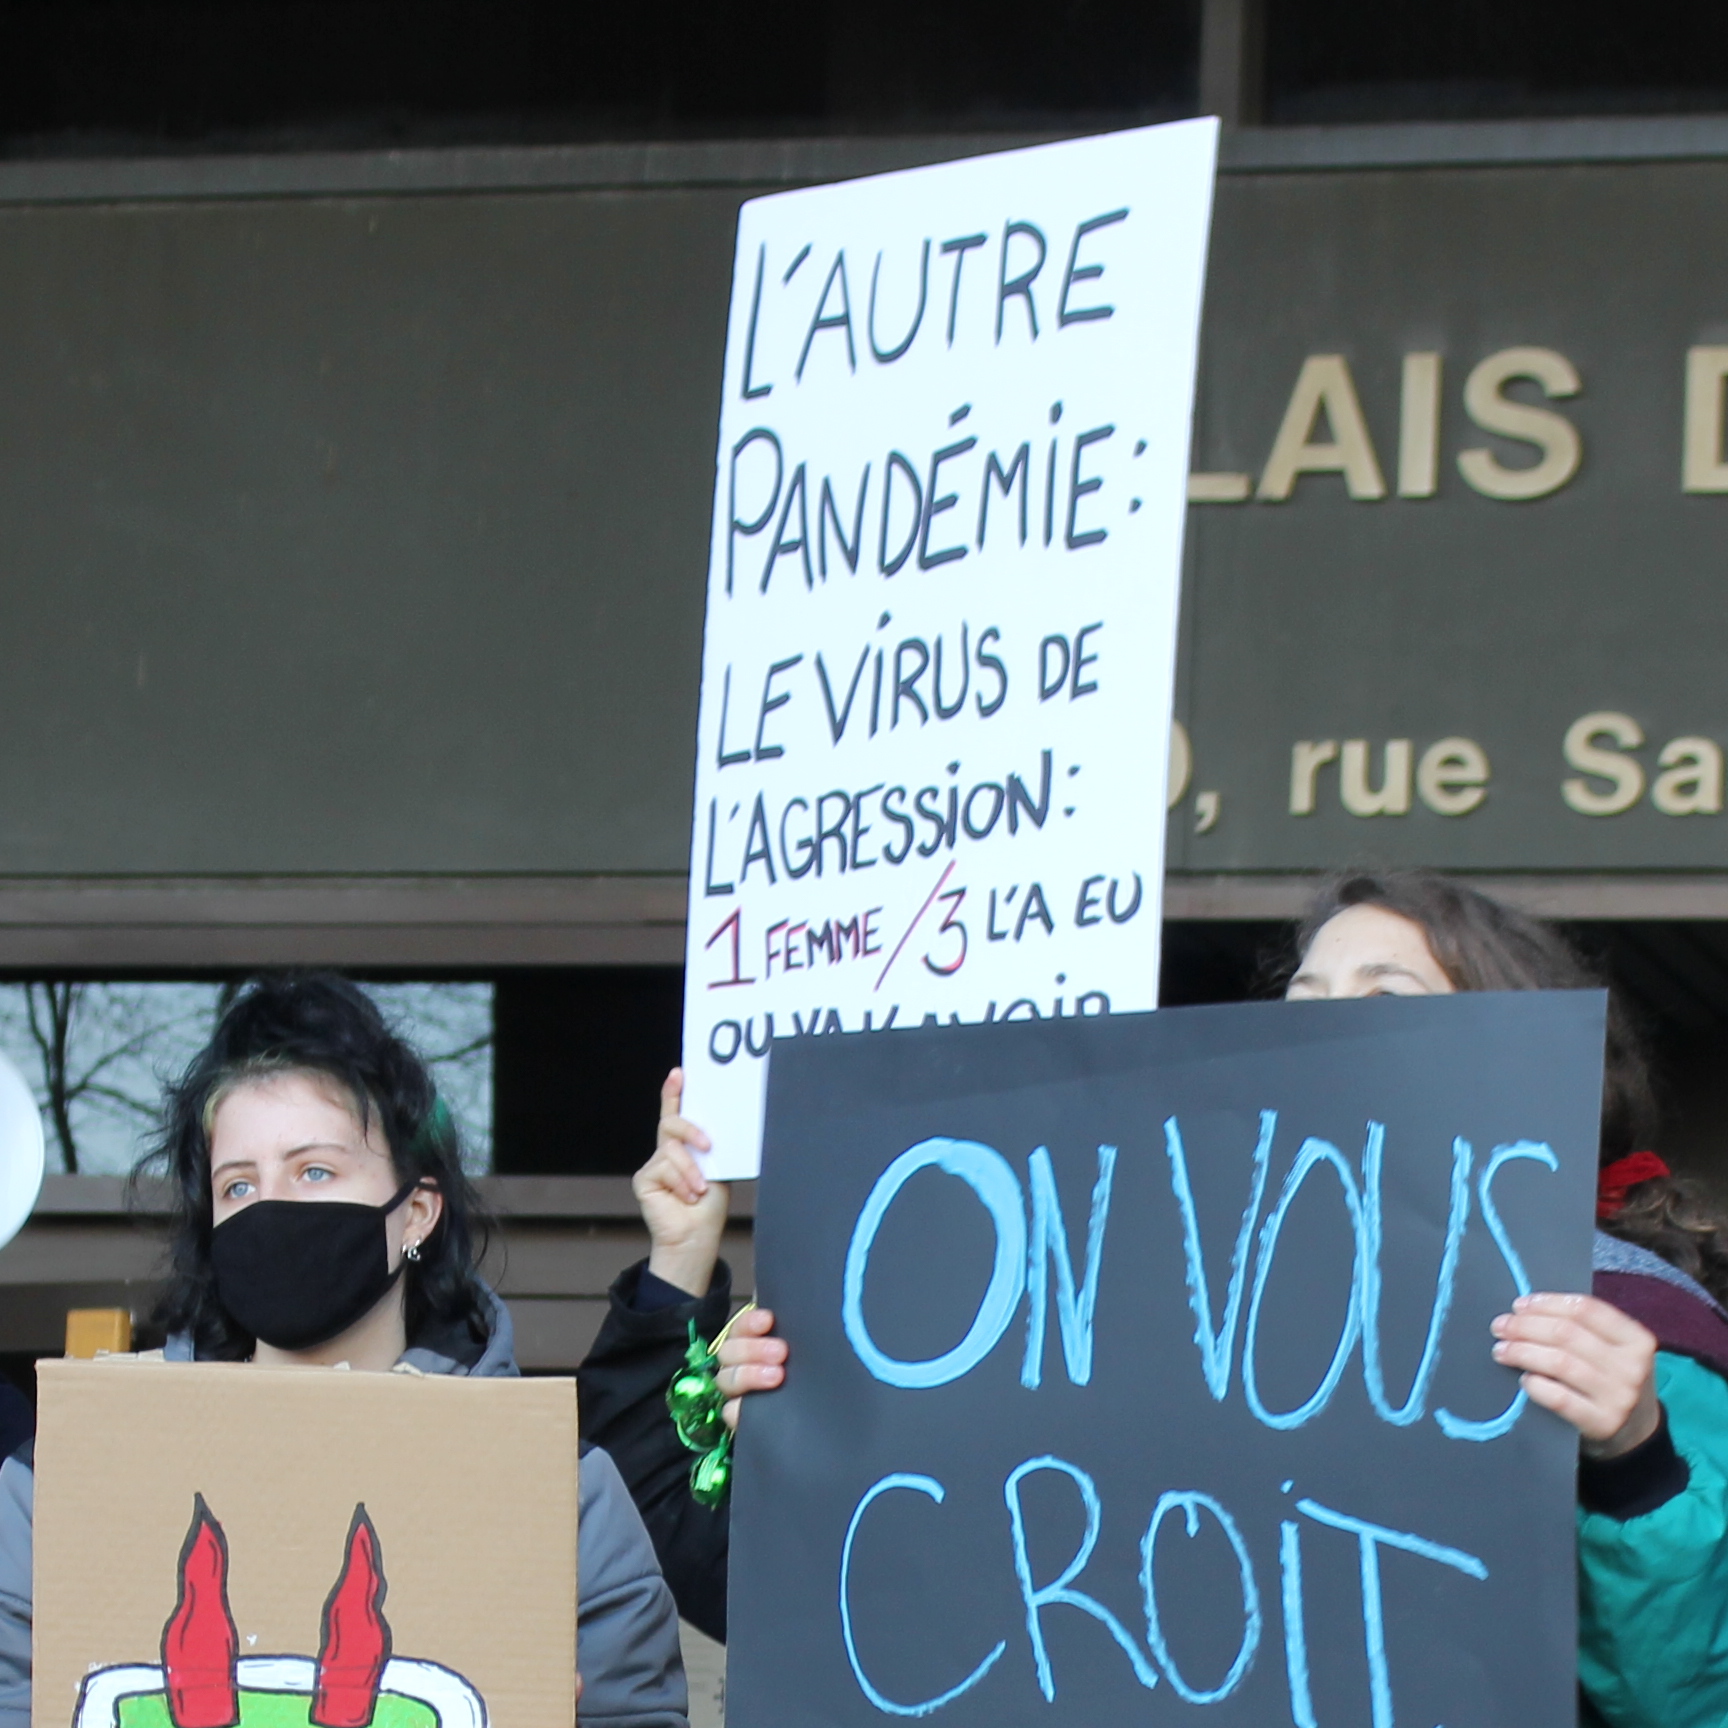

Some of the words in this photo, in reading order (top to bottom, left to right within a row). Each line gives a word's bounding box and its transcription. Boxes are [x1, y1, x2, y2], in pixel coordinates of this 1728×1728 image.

[742, 206, 1131, 401] L'AUTRE
[1186, 344, 1585, 503] AIS
[717, 653, 804, 770] LE
[1038, 621, 1104, 704] DE
[1288, 735, 1491, 816] rue
[704, 906, 757, 991] 1
[987, 883, 1055, 943] L'A
[1073, 871, 1144, 930] EU
[708, 1010, 773, 1067] OU
[842, 1135, 1119, 1390] ON
[1163, 1109, 1559, 1441] VOUS
